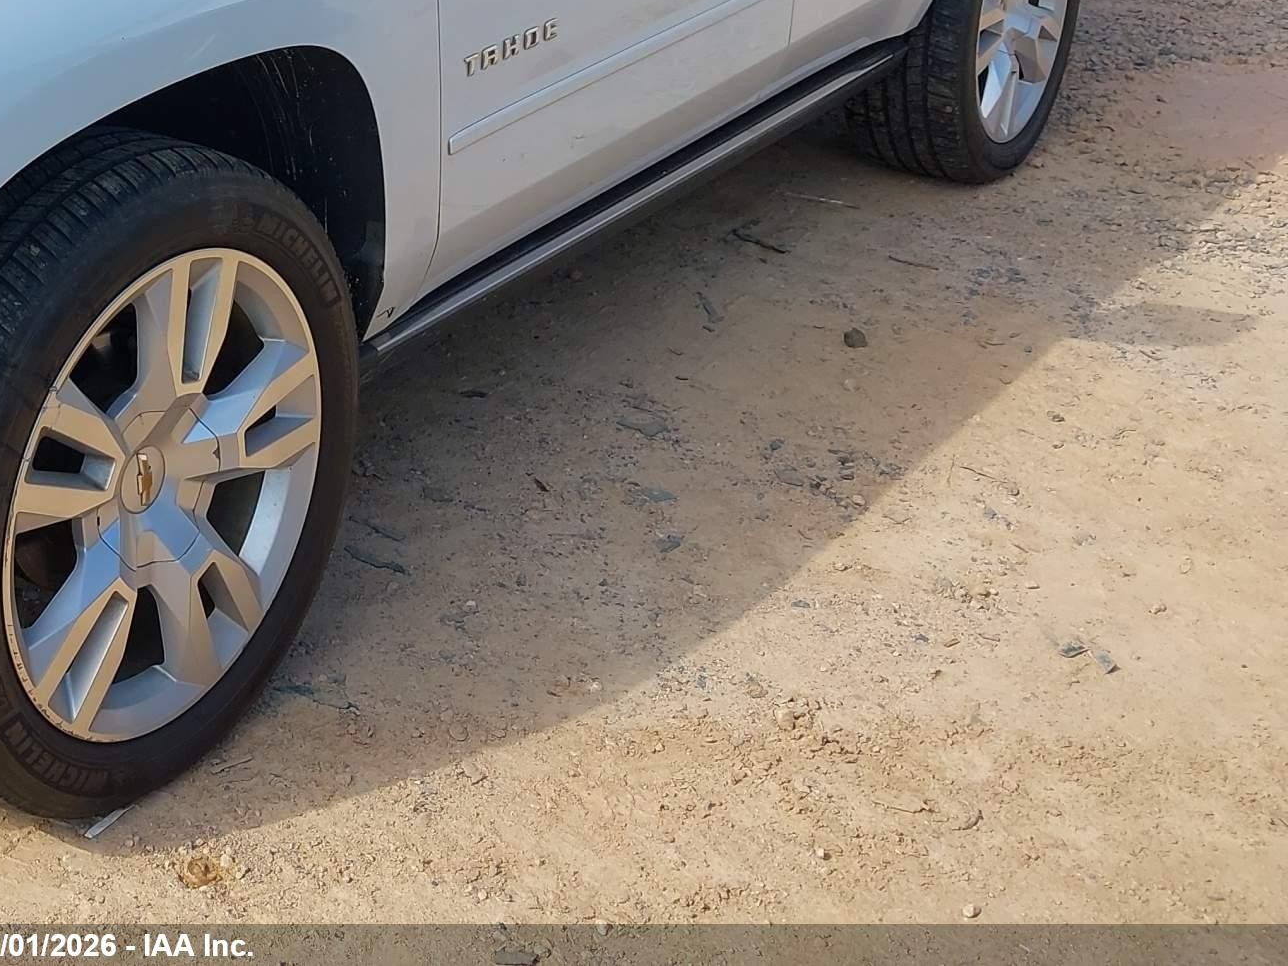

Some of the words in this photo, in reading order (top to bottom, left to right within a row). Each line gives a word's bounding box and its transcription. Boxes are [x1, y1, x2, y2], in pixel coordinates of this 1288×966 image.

[464, 17, 559, 77] TAHOE
[257, 213, 337, 301] MICHELIN
[6, 720, 109, 794] MICHELIN
